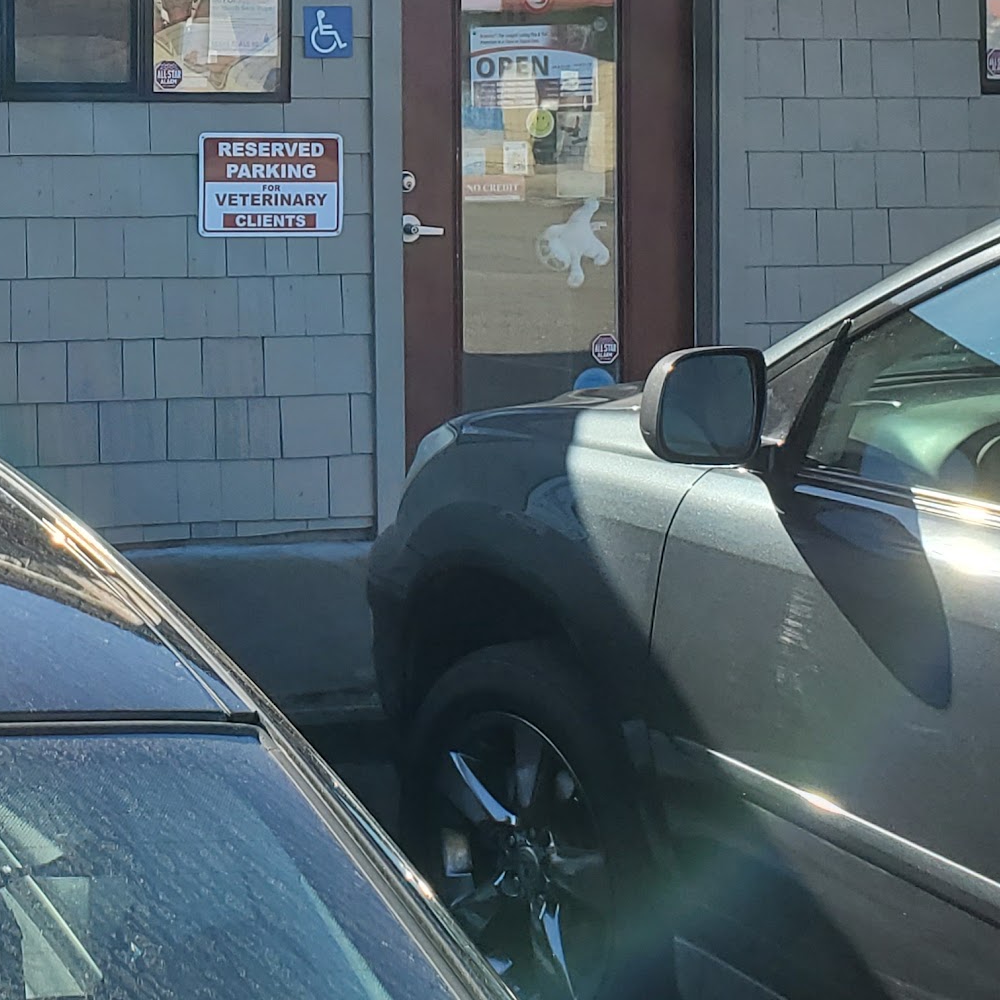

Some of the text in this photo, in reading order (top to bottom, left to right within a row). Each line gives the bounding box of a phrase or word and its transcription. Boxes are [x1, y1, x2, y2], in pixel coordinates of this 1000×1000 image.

[476, 55, 549, 78] OPEN
[217, 141, 325, 158] RESERVED
[226, 163, 317, 179] PARKING
[262, 184, 281, 192] FOR
[467, 183, 520, 193] NO CREDIT
[215, 193, 328, 206] VETERINARY
[234, 214, 307, 228] CLIENTS
